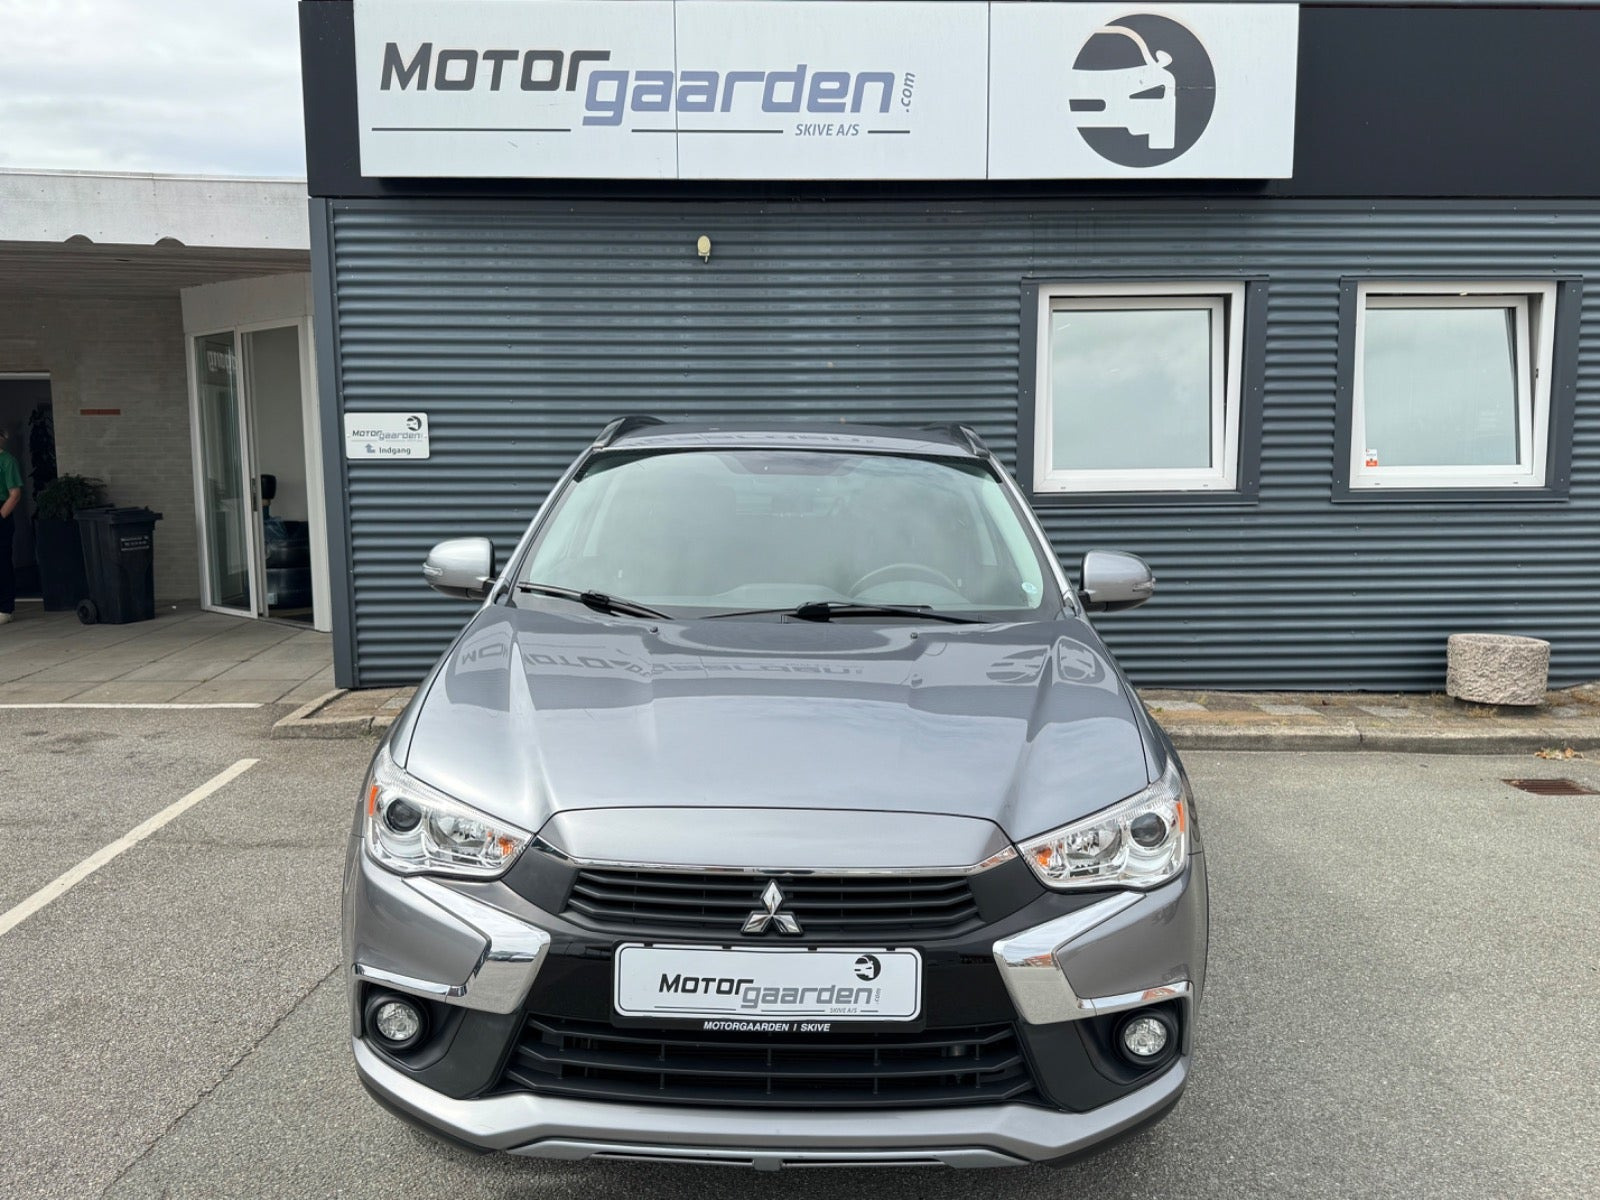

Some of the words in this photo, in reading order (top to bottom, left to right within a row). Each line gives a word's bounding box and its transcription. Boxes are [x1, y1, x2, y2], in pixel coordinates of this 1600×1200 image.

[901, 72, 916, 113] .com
[795, 123, 834, 137] SKIVE
[836, 123, 860, 137] A/S
[379, 447, 411, 455] Indgang
[703, 1021, 790, 1032] MOTORGAARDEN
[800, 1023, 832, 1032] SKIVE
